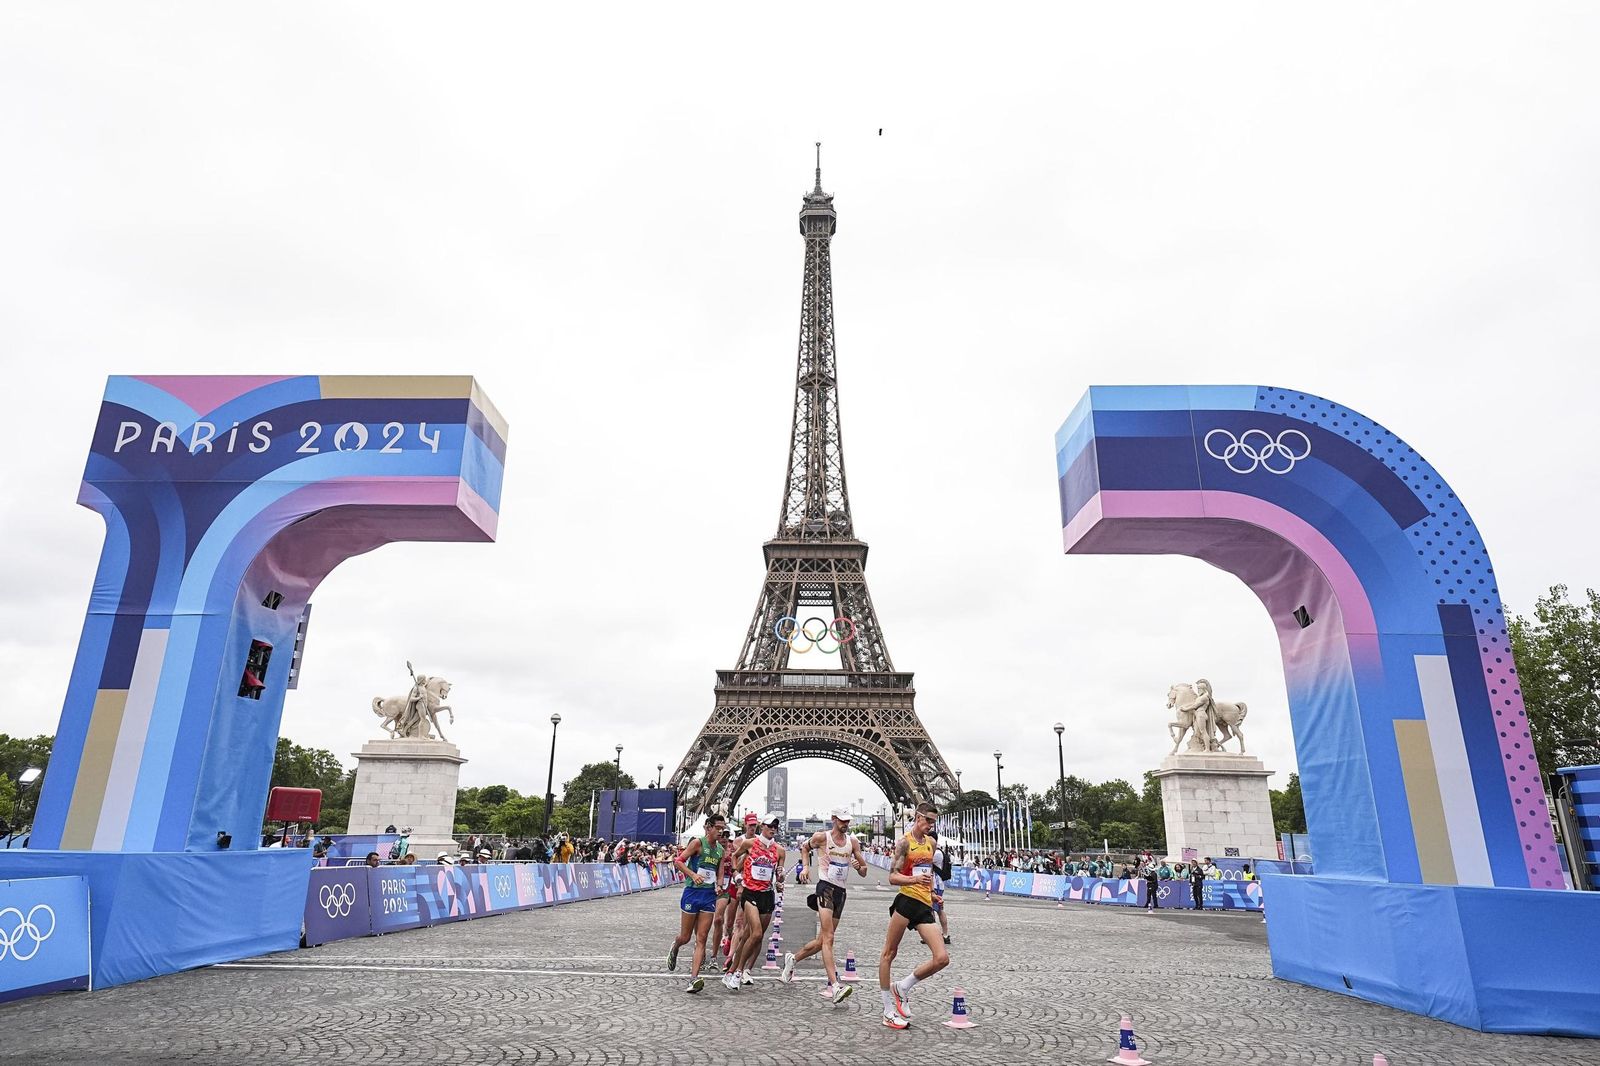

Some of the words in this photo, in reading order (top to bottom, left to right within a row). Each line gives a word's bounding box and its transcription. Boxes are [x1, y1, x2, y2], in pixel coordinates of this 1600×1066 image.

[296, 421, 440, 453] 2024
[383, 896, 408, 914] 2024
[1190, 893, 1213, 901] 224
